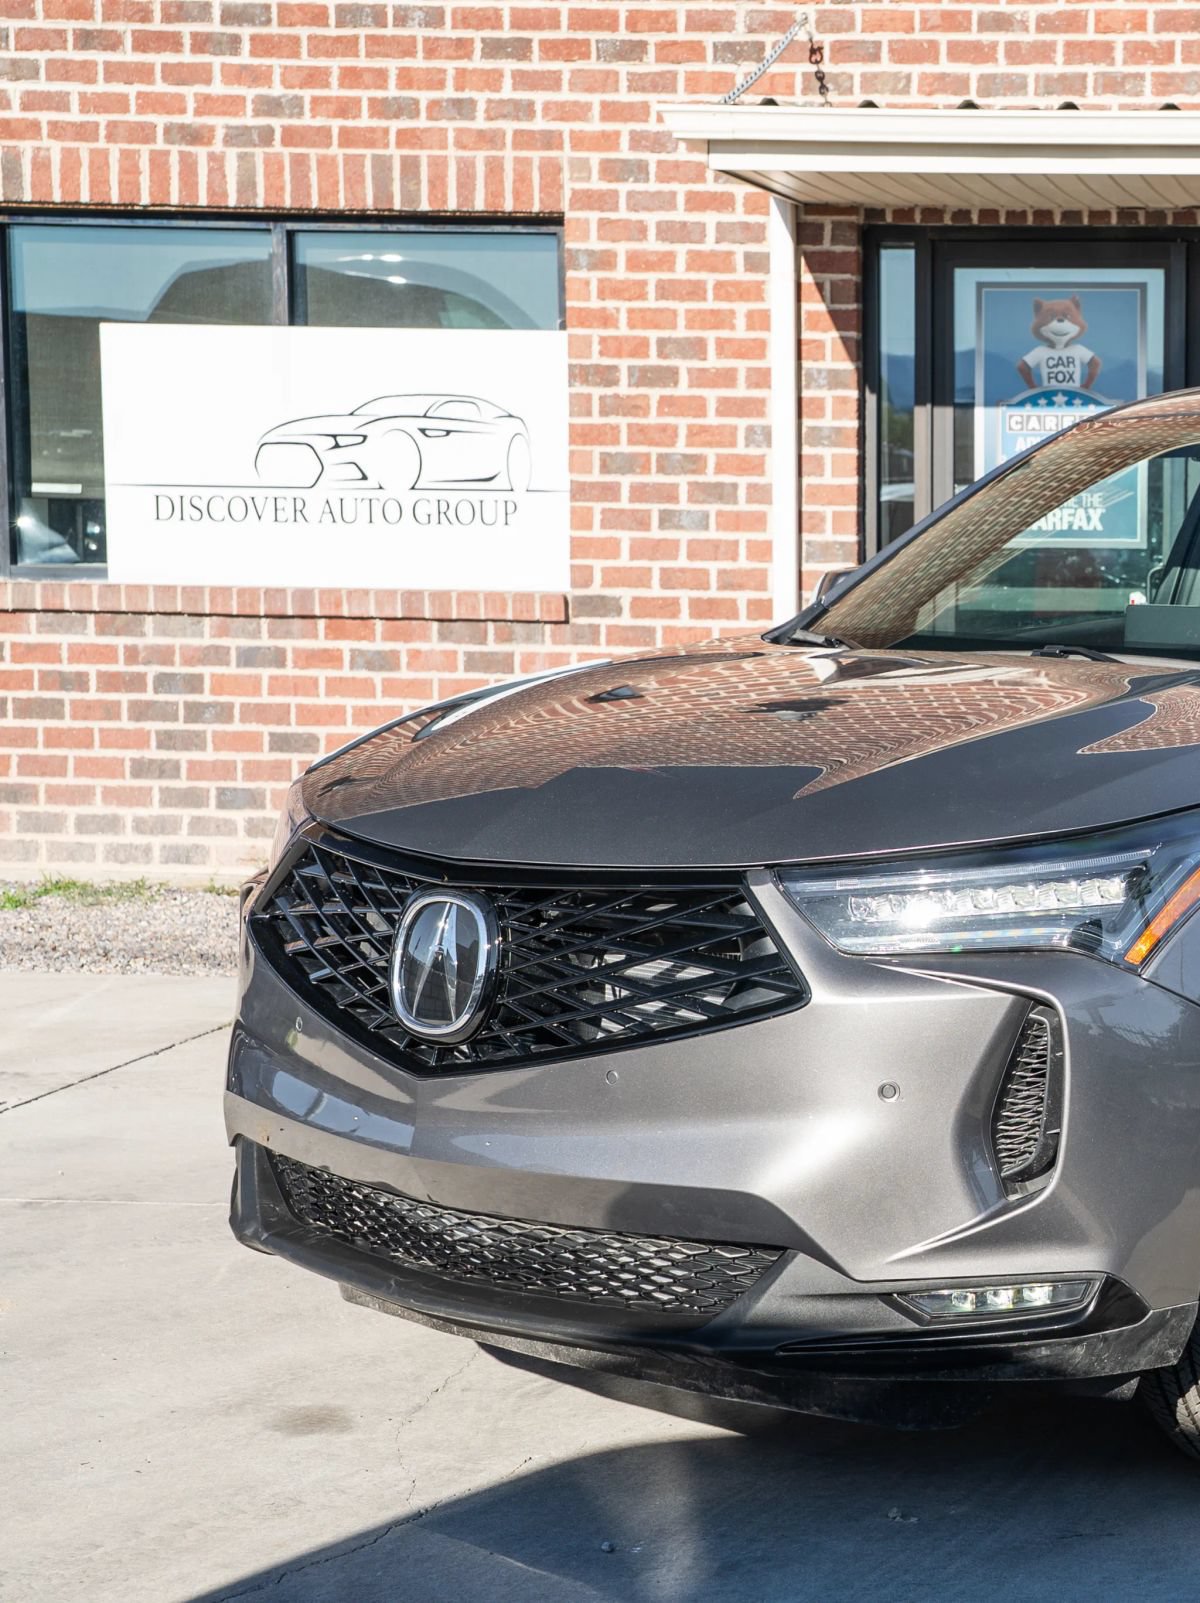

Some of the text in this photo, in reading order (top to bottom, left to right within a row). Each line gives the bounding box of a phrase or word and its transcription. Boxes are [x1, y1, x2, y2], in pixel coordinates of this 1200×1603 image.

[1046, 355, 1076, 369] CAR
[1047, 370, 1076, 384] FOX
[1081, 493, 1104, 508] THE
[153, 494, 518, 527] DISCOVER AUTO GROUP
[1029, 508, 1104, 531] ARFAX
